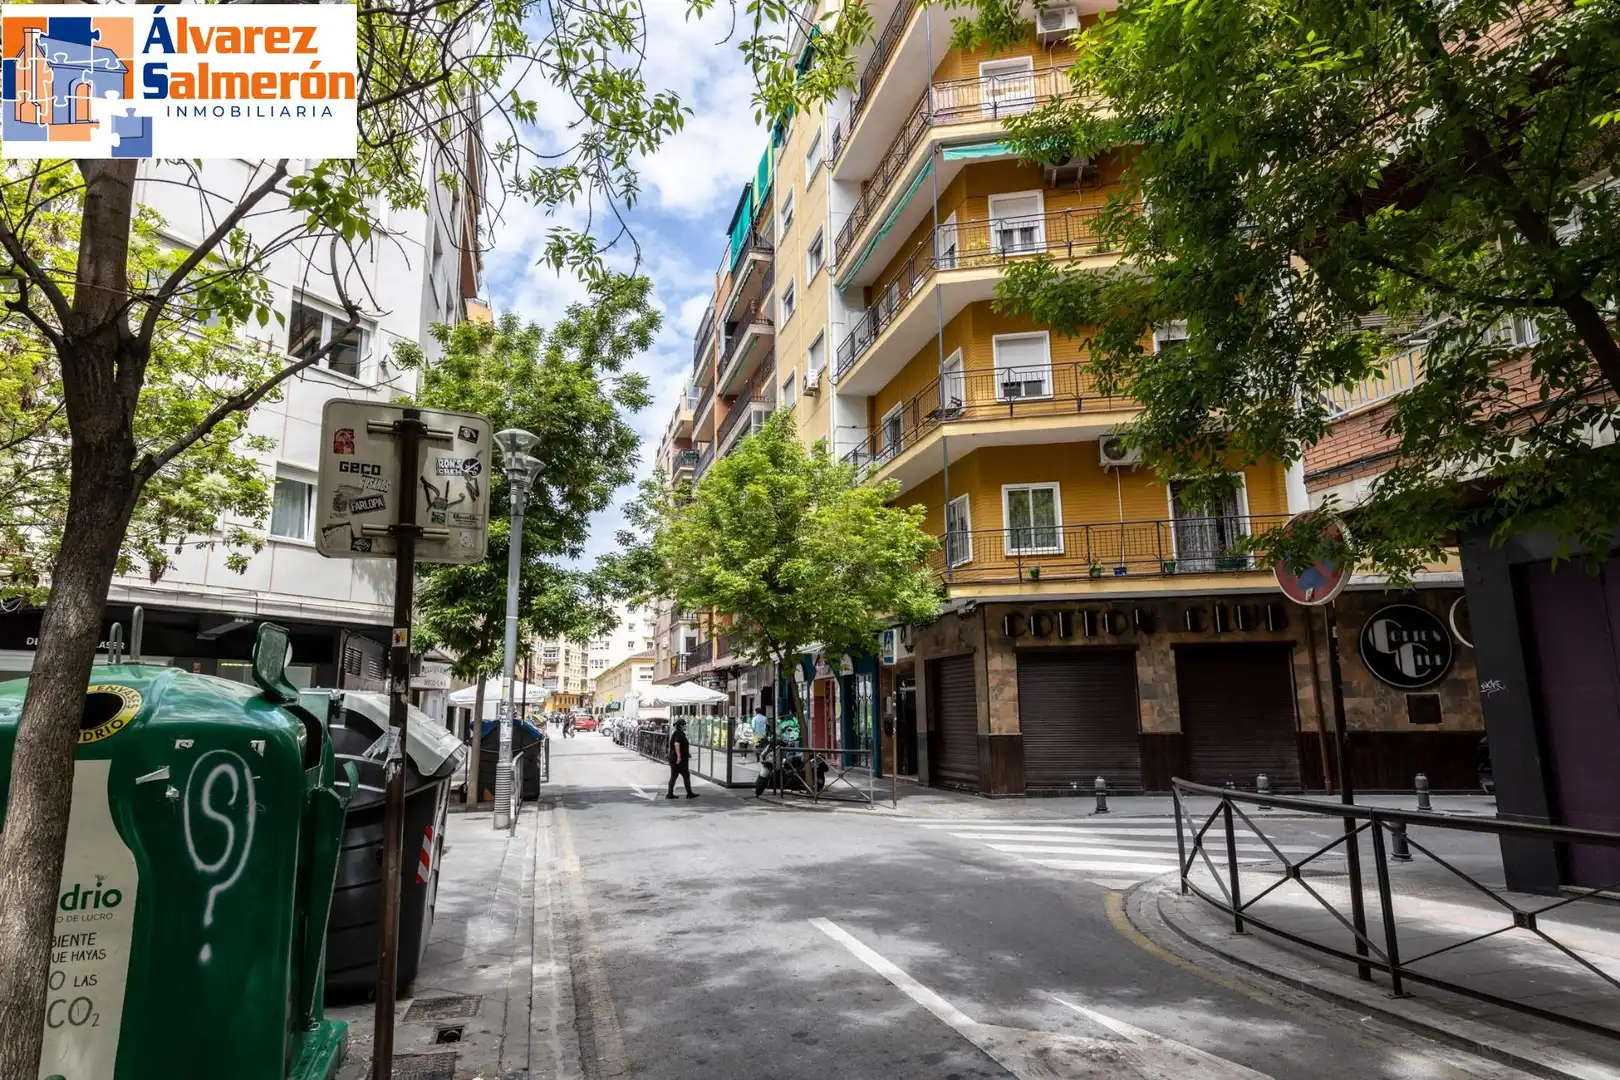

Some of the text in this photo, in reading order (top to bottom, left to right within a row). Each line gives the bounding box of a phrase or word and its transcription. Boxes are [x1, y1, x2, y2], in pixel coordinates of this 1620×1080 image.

[97, 685, 139, 709] ENVASES
[60, 881, 122, 911] drio
[82, 912, 113, 921] LUCRO
[52, 932, 97, 948] BIENTE
[52, 949, 107, 963] UE HAYAS
[49, 970, 98, 990] O LAS
